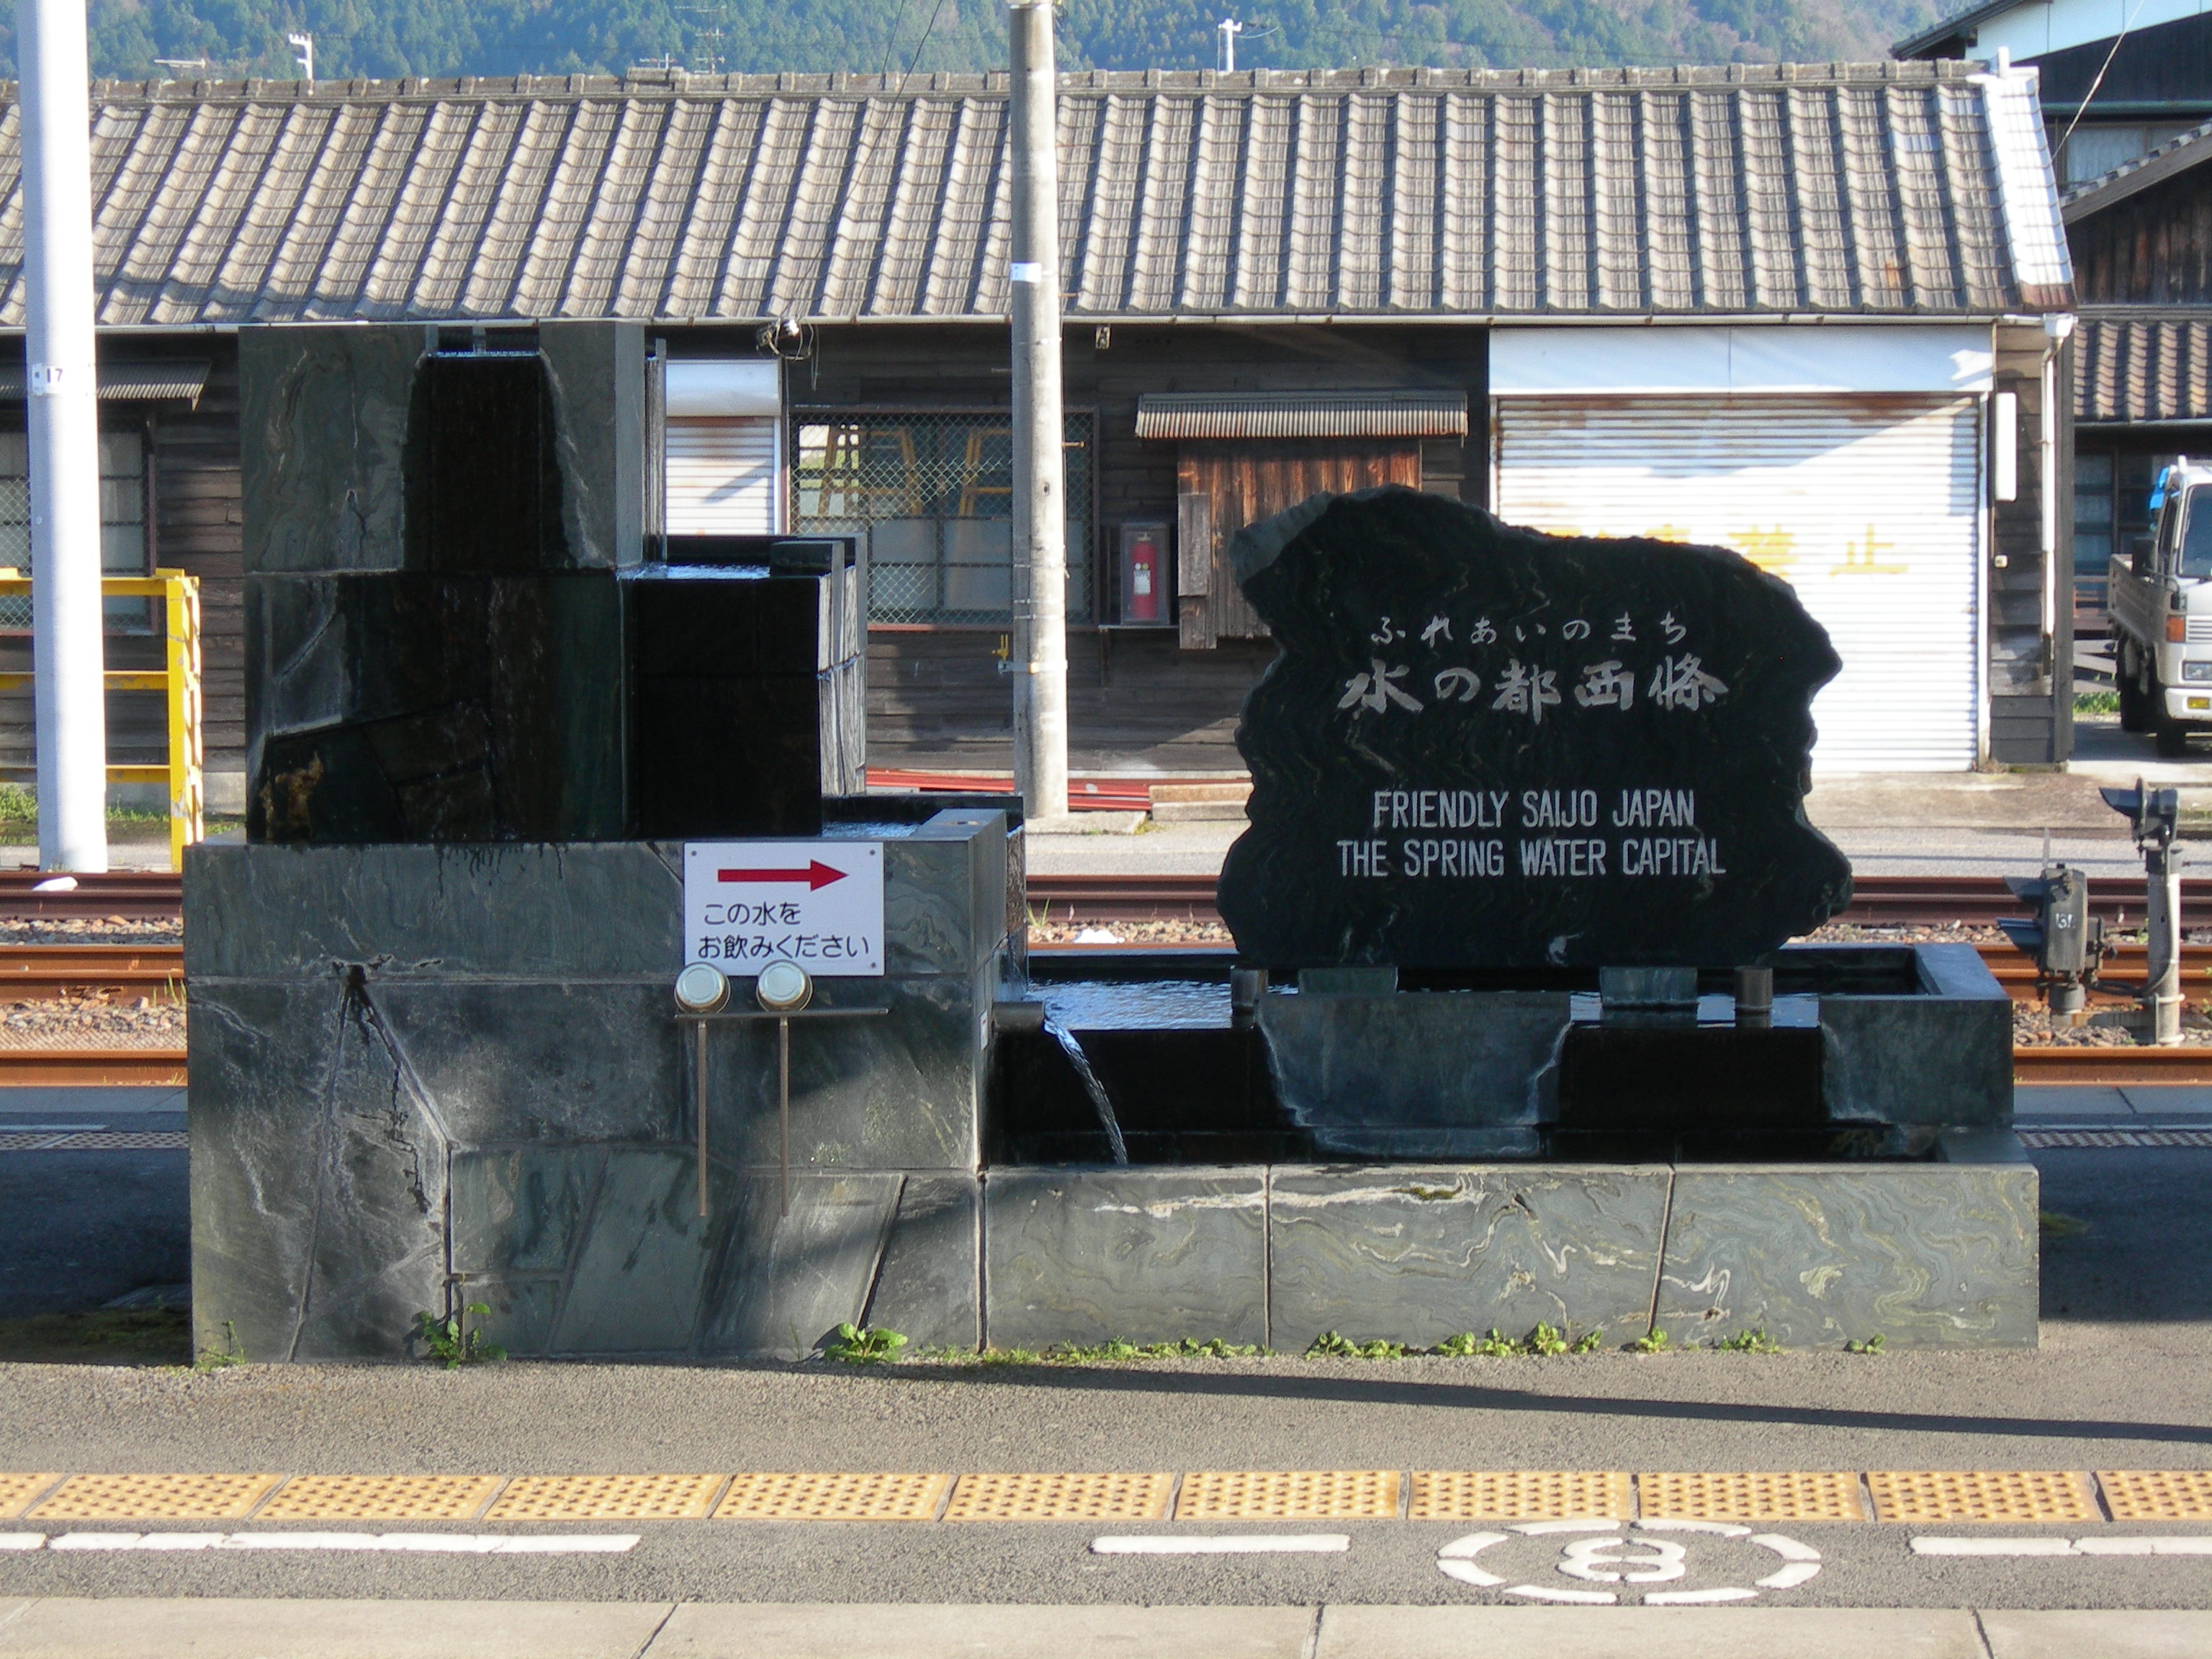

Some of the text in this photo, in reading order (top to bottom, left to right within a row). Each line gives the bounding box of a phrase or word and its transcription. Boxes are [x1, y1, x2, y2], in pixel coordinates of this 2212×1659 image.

[47, 368, 63, 383] 17
[1371, 611, 1686, 645] ふれあいのまち
[1373, 789, 1695, 829] FRIENDLY SAIJO JAPAN
[1337, 838, 1727, 877] THE SPRING WATER CAPITAL
[703, 901, 801, 927] この水を
[698, 934, 869, 959] お飲みください
[1555, 1536, 1686, 1583] 8
